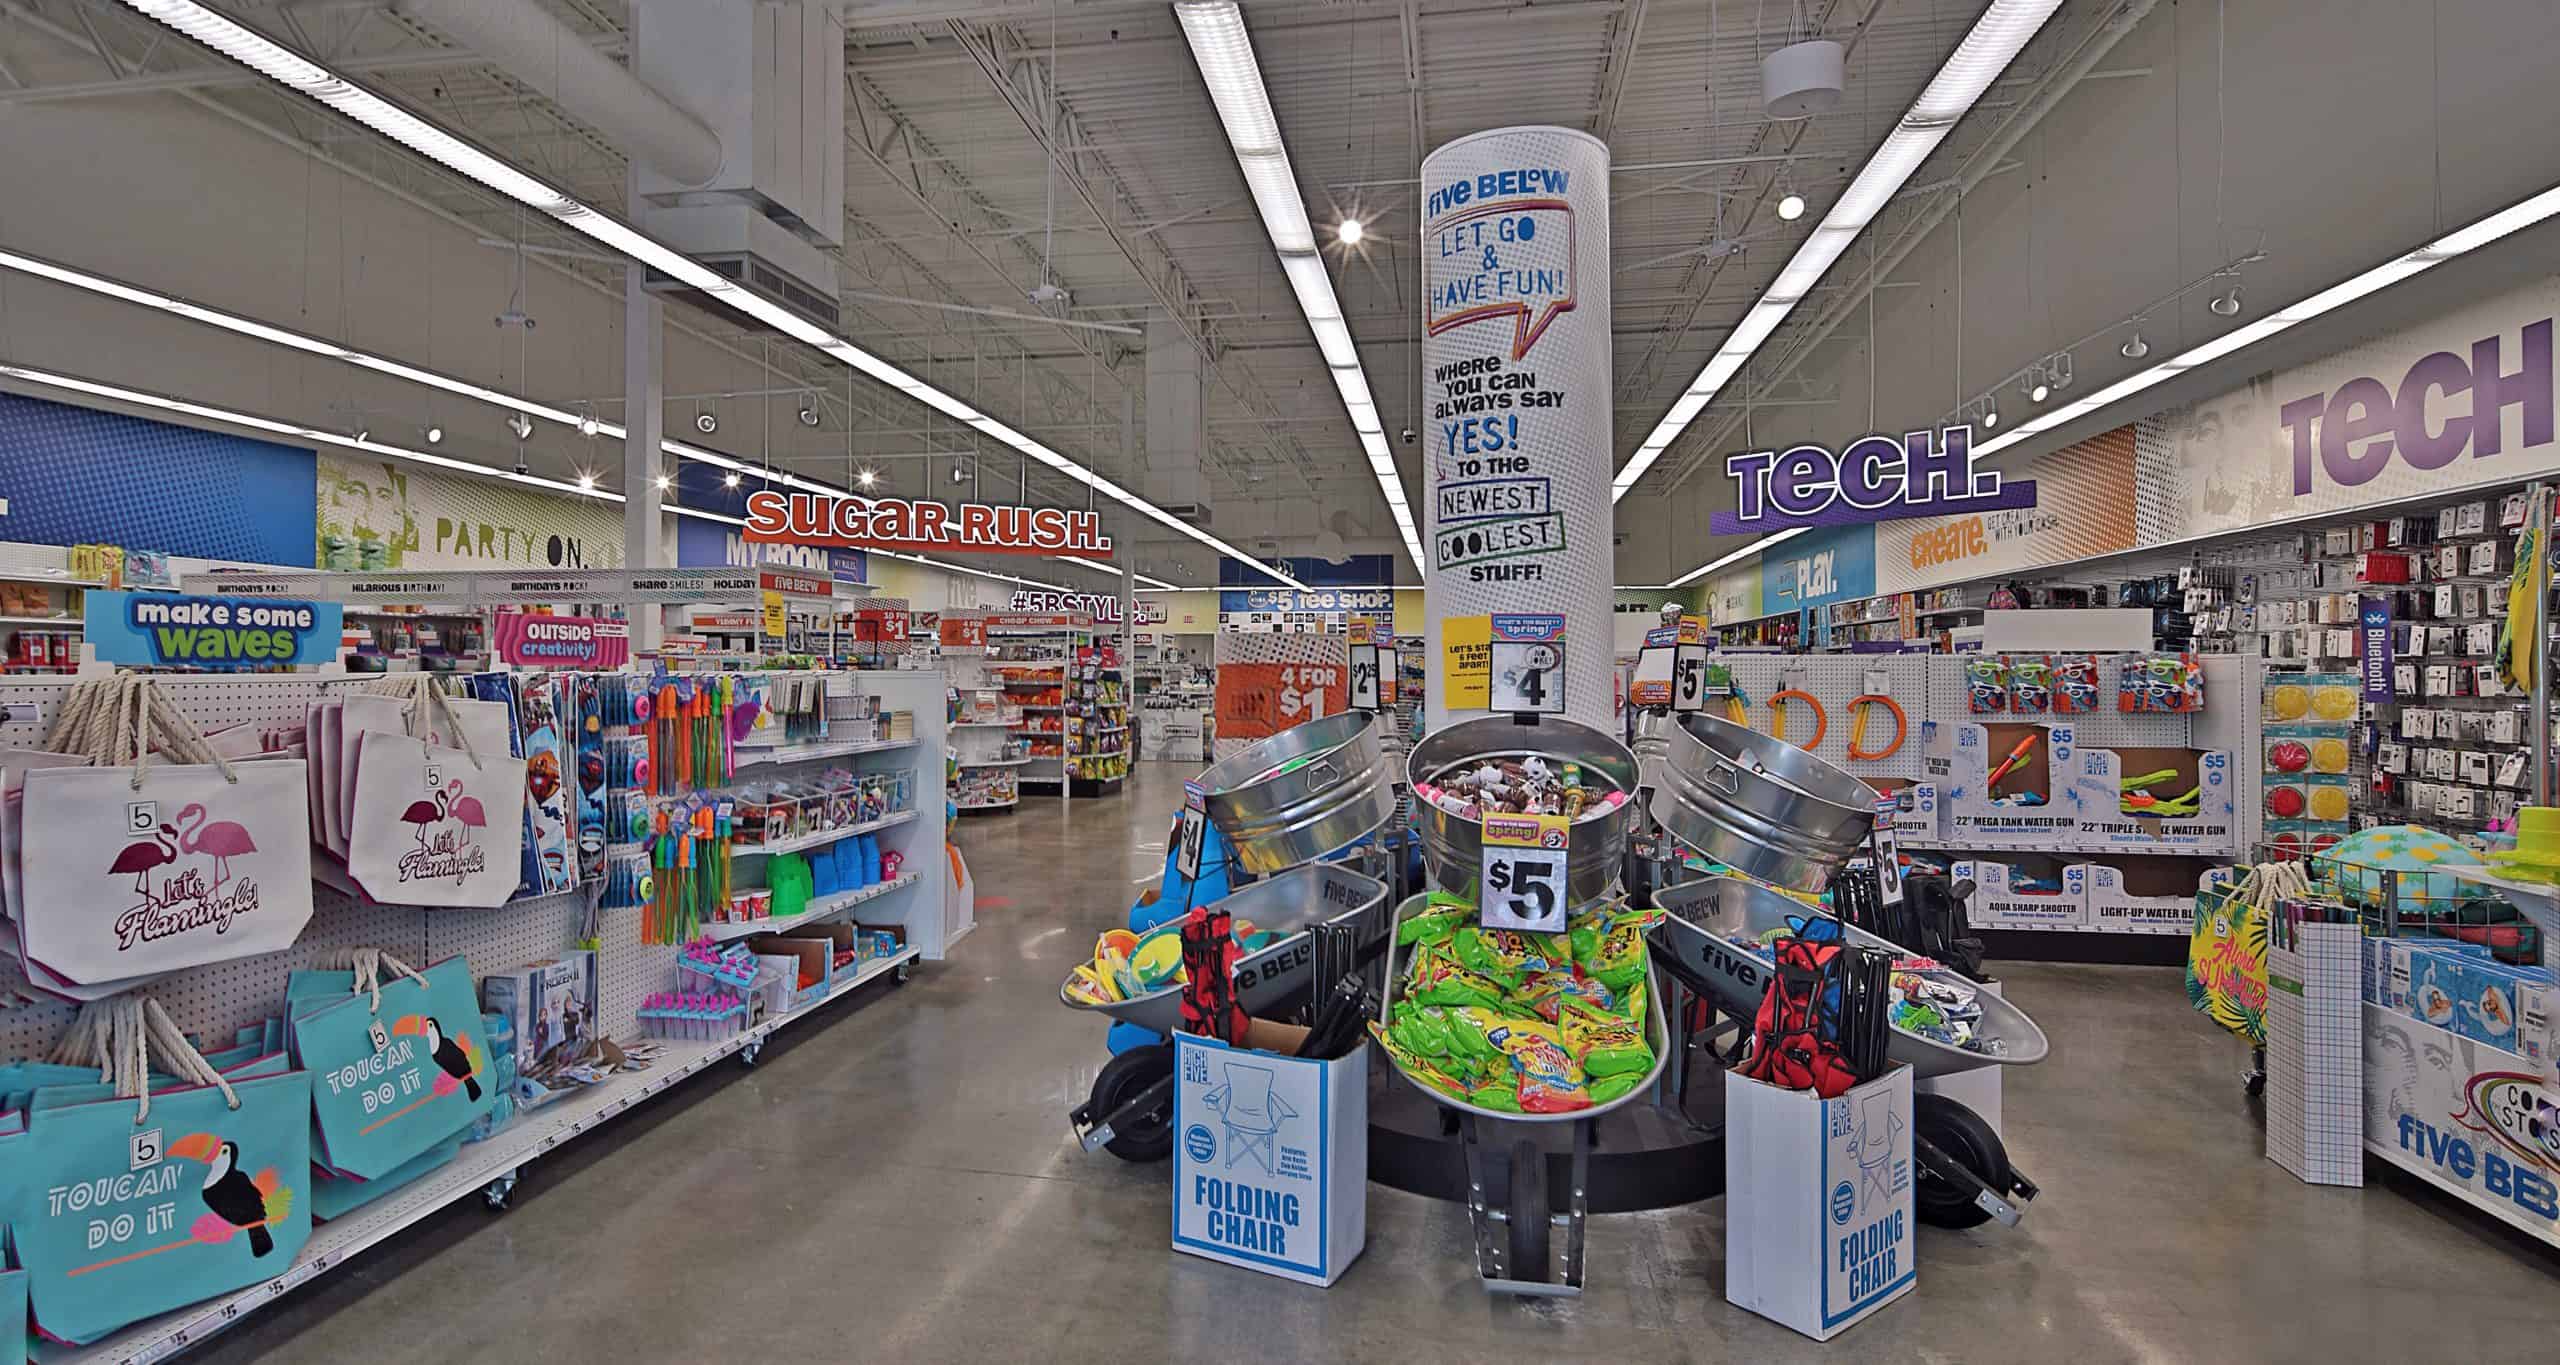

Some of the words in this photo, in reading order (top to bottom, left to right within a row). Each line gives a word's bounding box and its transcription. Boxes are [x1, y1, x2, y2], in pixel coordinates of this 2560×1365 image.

[1429, 180, 1471, 217] five
[1477, 169, 1569, 198] BELOW
[1441, 221, 1486, 257] LET
[1499, 216, 1535, 243] GO
[1482, 244, 1499, 270] &
[1433, 274, 1486, 312] HAVE
[1498, 269, 1563, 296] FUN!
[1443, 414, 1518, 456] YES!
[1458, 460, 1481, 477] TO
[1443, 486, 1540, 515] NEWEST
[436, 518, 536, 563] PARTY
[547, 534, 588, 570] ON.
[1440, 521, 1550, 561] COOLEST
[1995, 525, 2013, 544] WITH
[727, 541, 763, 567] MY
[766, 544, 829, 571] ROOM
[670, 581, 703, 591] SMILES!
[775, 576, 793, 589] five
[137, 602, 227, 626] make
[236, 606, 311, 628] some
[886, 620, 906, 639] $1
[157, 628, 295, 660] waves
[521, 642, 596, 660] creativity!
[1281, 667, 1296, 684] 4
[1302, 668, 1336, 686] FOR
[1504, 668, 1546, 706] $4
[2052, 729, 2073, 744] $5
[2206, 754, 2225, 768] $5
[428, 767, 439, 785] 5
[1918, 787, 1934, 798] $5
[134, 806, 152, 828] 5
[1893, 821, 1927, 830] SHOOTER
[1974, 816, 1999, 828] MEGA
[2001, 817, 2023, 828] TANK
[2024, 817, 2055, 828] WATER
[2056, 817, 2075, 829] GUN
[2101, 823, 2132, 834] TRIPLE
[2171, 825, 2205, 835] WATER
[2207, 826, 2226, 835] GUN
[1955, 866, 1971, 877] $5
[2067, 869, 2083, 880] $5
[1487, 859, 1555, 920] $5
[115, 877, 258, 951] Flamingle!
[1989, 902, 2011, 912] AQUA
[2013, 903, 2038, 913] SHARP
[2040, 904, 2077, 913] SHOOTER
[2100, 907, 2144, 917] LIGHT-UP
[2146, 908, 2179, 918] WATER
[2216, 919, 2225, 934] 5
[1261, 944, 1312, 981] BELO
[1702, 944, 1757, 986] five
[2214, 932, 2257, 972] Aloha
[2198, 958, 2267, 1008] SUMMER
[326, 1039, 415, 1097] TOUCAN
[361, 1080, 396, 1114] DO
[400, 1068, 421, 1096] IT
[138, 1139, 155, 1162] 5
[2397, 1113, 2476, 1179] five
[49, 1164, 183, 1216] TOUCAN
[1195, 1174, 1299, 1227] FOLDING
[88, 1214, 134, 1250] DO
[147, 1203, 176, 1234] IT
[1208, 1211, 1285, 1256] CHAIR
[1840, 1208, 1903, 1273] FOLDING
[1850, 1247, 1896, 1302] CHAIR
